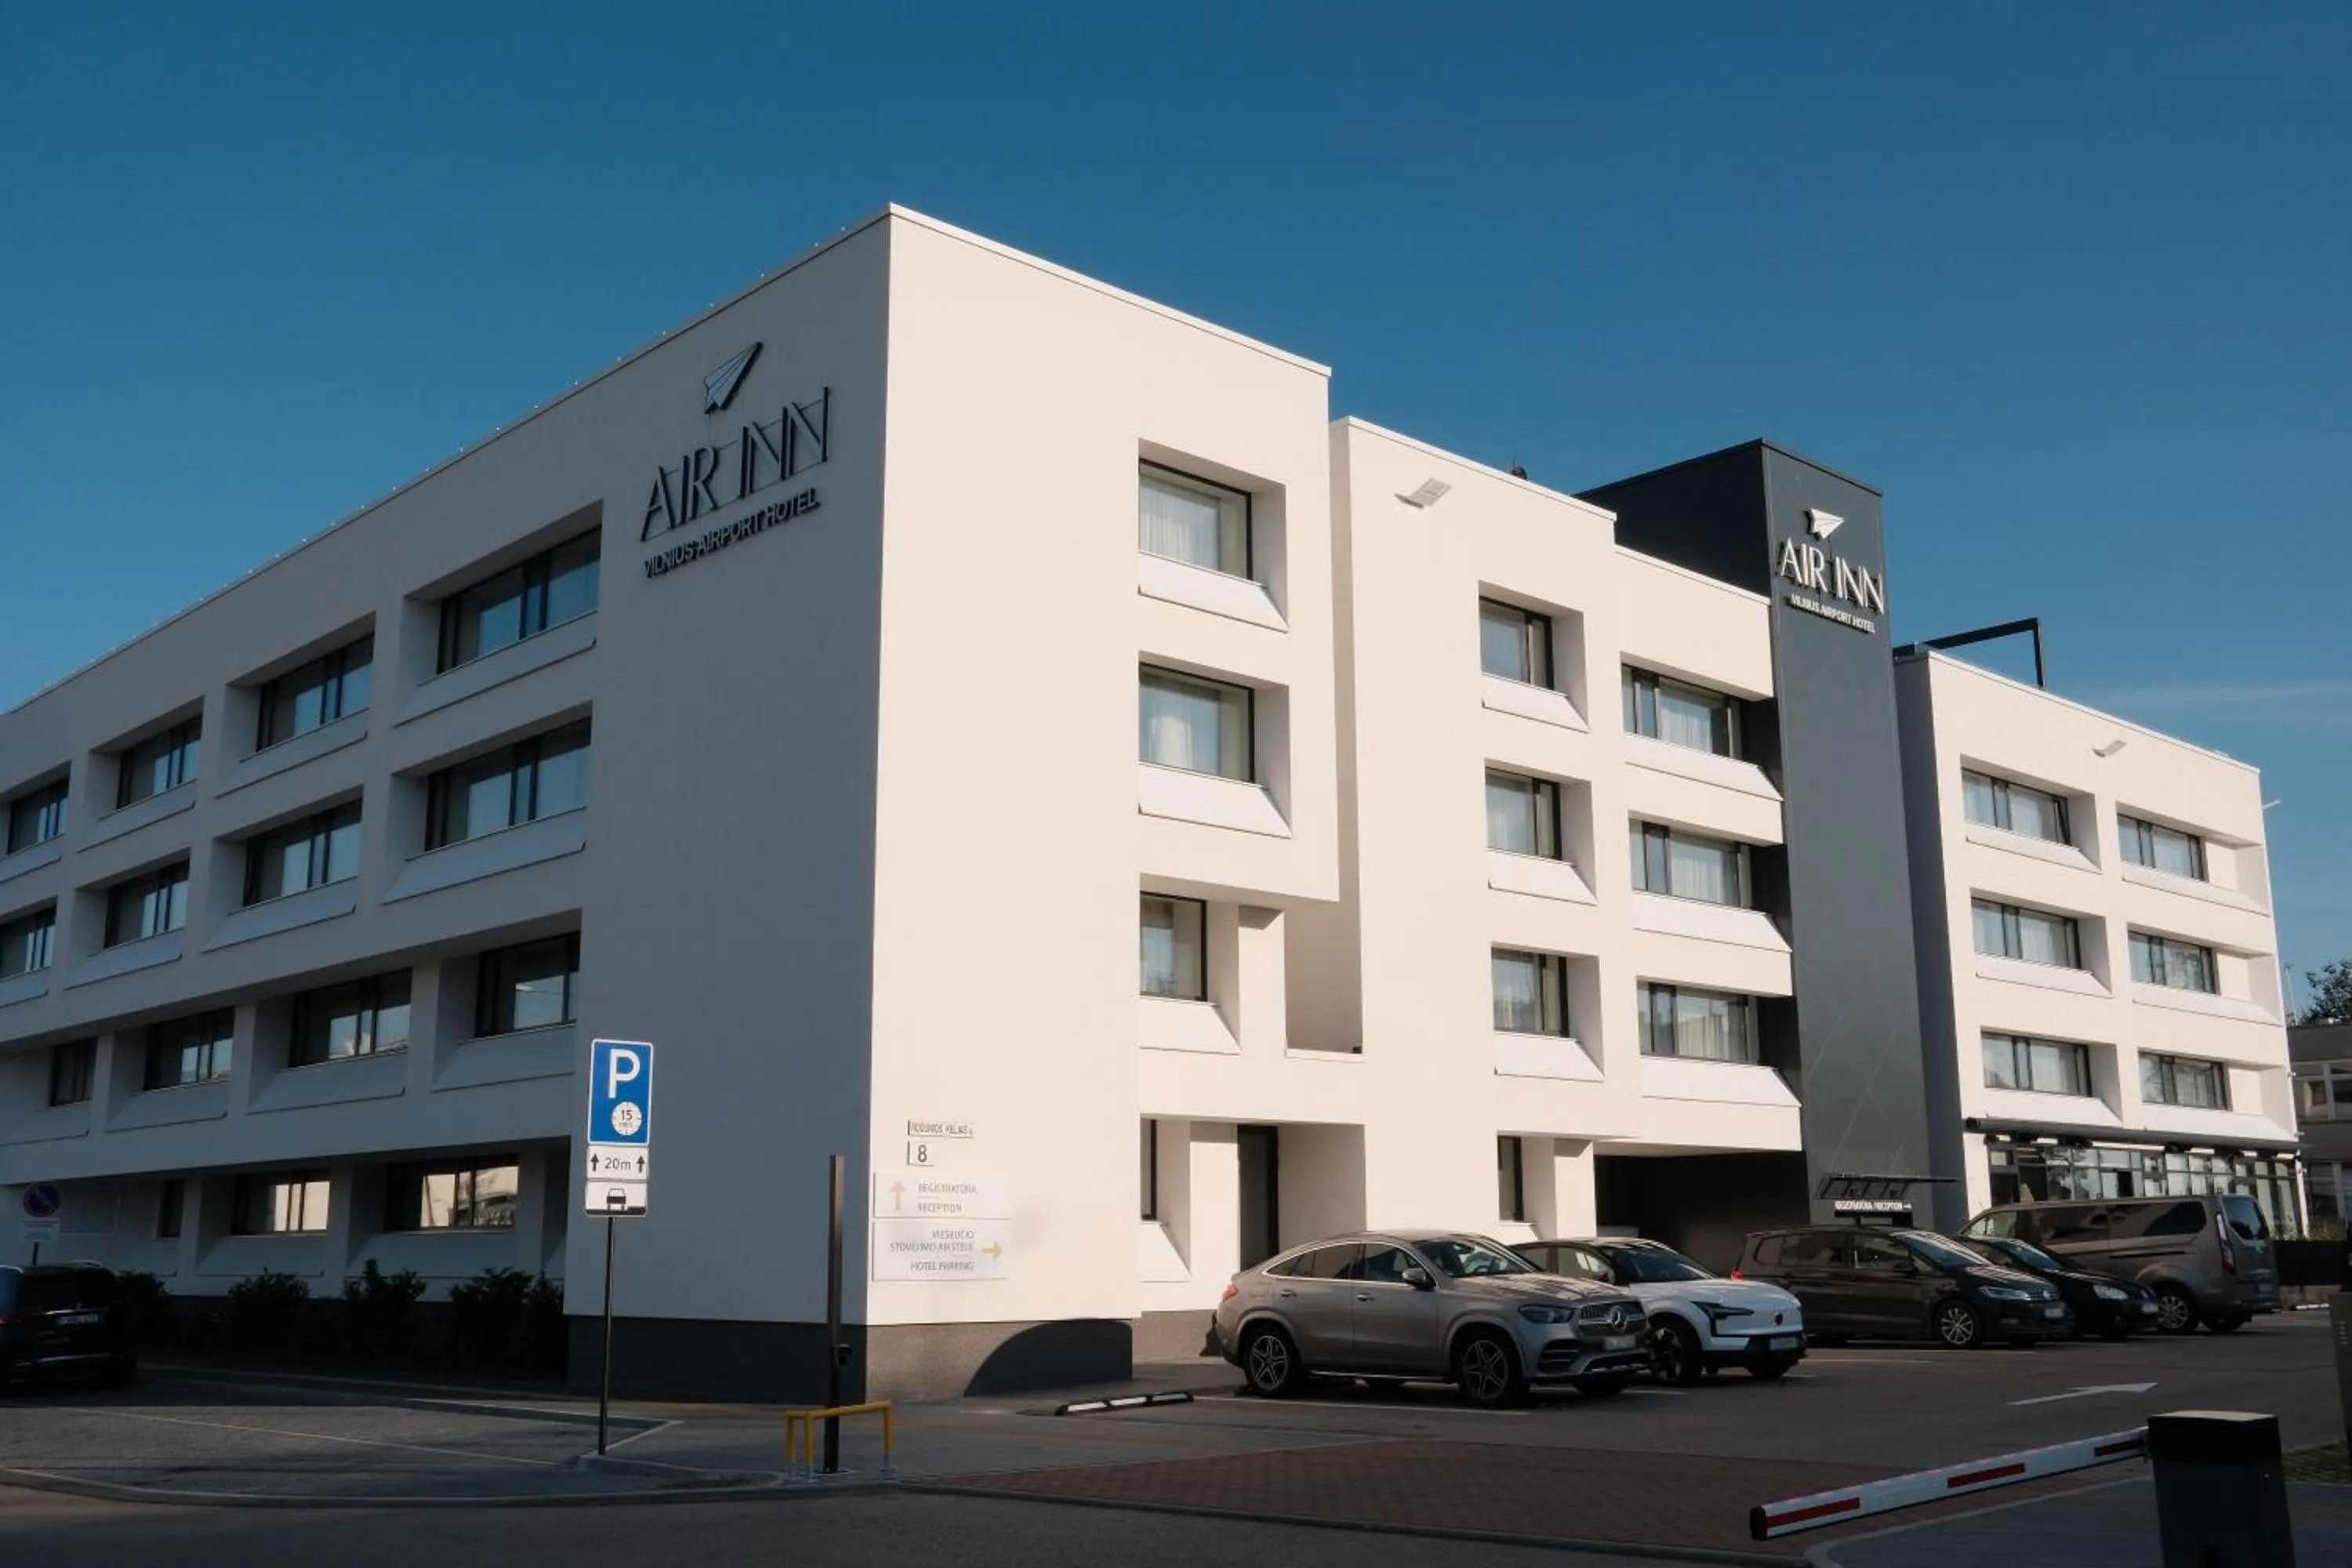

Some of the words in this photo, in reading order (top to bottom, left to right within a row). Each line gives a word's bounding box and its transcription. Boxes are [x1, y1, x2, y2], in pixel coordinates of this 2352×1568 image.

[640, 445, 719, 542] AIR
[739, 387, 829, 499] INN
[644, 543, 696, 578] VILNIUS
[695, 513, 760, 555] AIRPORT
[764, 487, 821, 528] HOTEL
[1780, 537, 1828, 593] AIR
[1835, 556, 1884, 615] INN
[1791, 593, 1820, 612] VILNIUS
[1820, 604, 1852, 624] AIRPORT
[1853, 615, 1876, 633] HOTEL
[608, 1048, 641, 1098] P
[621, 1109, 633, 1121] 15
[918, 1145, 927, 1163] 8
[917, 1203, 962, 1213] RECEPTION
[910, 1261, 938, 1271] HOTEL
